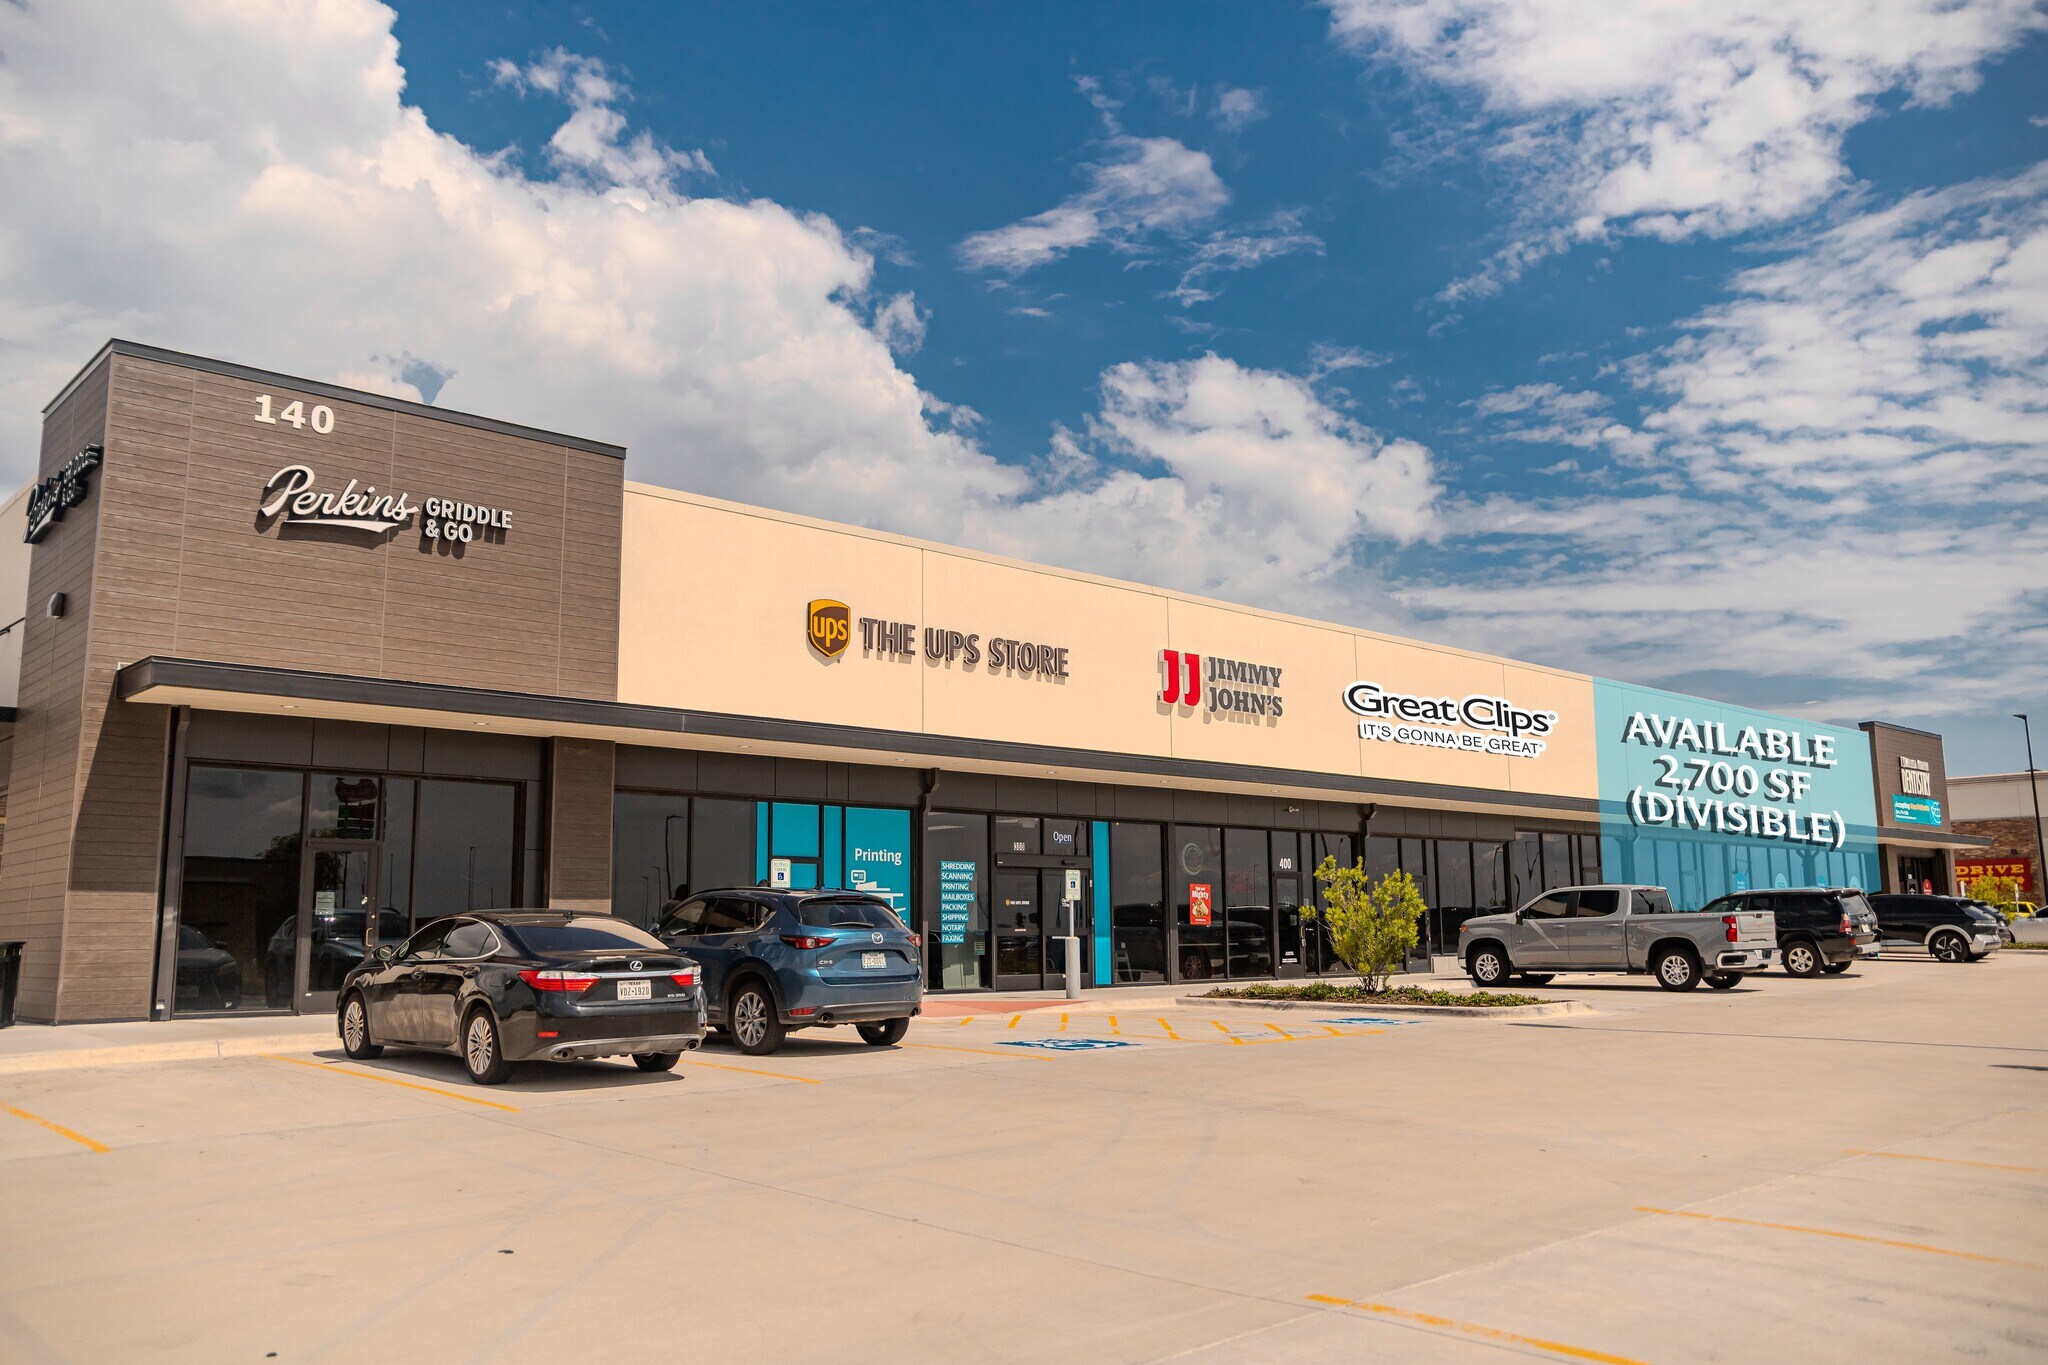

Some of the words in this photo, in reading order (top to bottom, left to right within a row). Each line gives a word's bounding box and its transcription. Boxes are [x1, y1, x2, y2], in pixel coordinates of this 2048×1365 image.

[254, 394, 334, 434] 140
[260, 464, 419, 522] Perkins
[426, 497, 512, 529] GRIDDLE
[425, 519, 439, 538] &
[444, 522, 473, 543] GO
[812, 616, 848, 648] ups
[860, 617, 915, 656] THE
[926, 627, 980, 665] UPS
[989, 637, 1069, 677] STORE
[1160, 649, 1200, 706] JJ
[1206, 656, 1282, 688] JIMMY
[1207, 687, 1283, 717] JOHN'S
[1348, 685, 1457, 721] Great
[1463, 698, 1550, 736] Clips
[1363, 724, 1391, 737] IT'S
[1397, 728, 1456, 745] GONNA
[1463, 735, 1482, 748] BE
[1488, 739, 1538, 754] GREAT
[1053, 831, 1072, 843] Open
[855, 848, 902, 866] Printing
[941, 862, 975, 870] SHREDDING
[1279, 858, 1292, 869] 400
[1955, 864, 2025, 875] DRIVE
[941, 872, 973, 880] SCANNING
[942, 893, 975, 901] MAILBOXES
